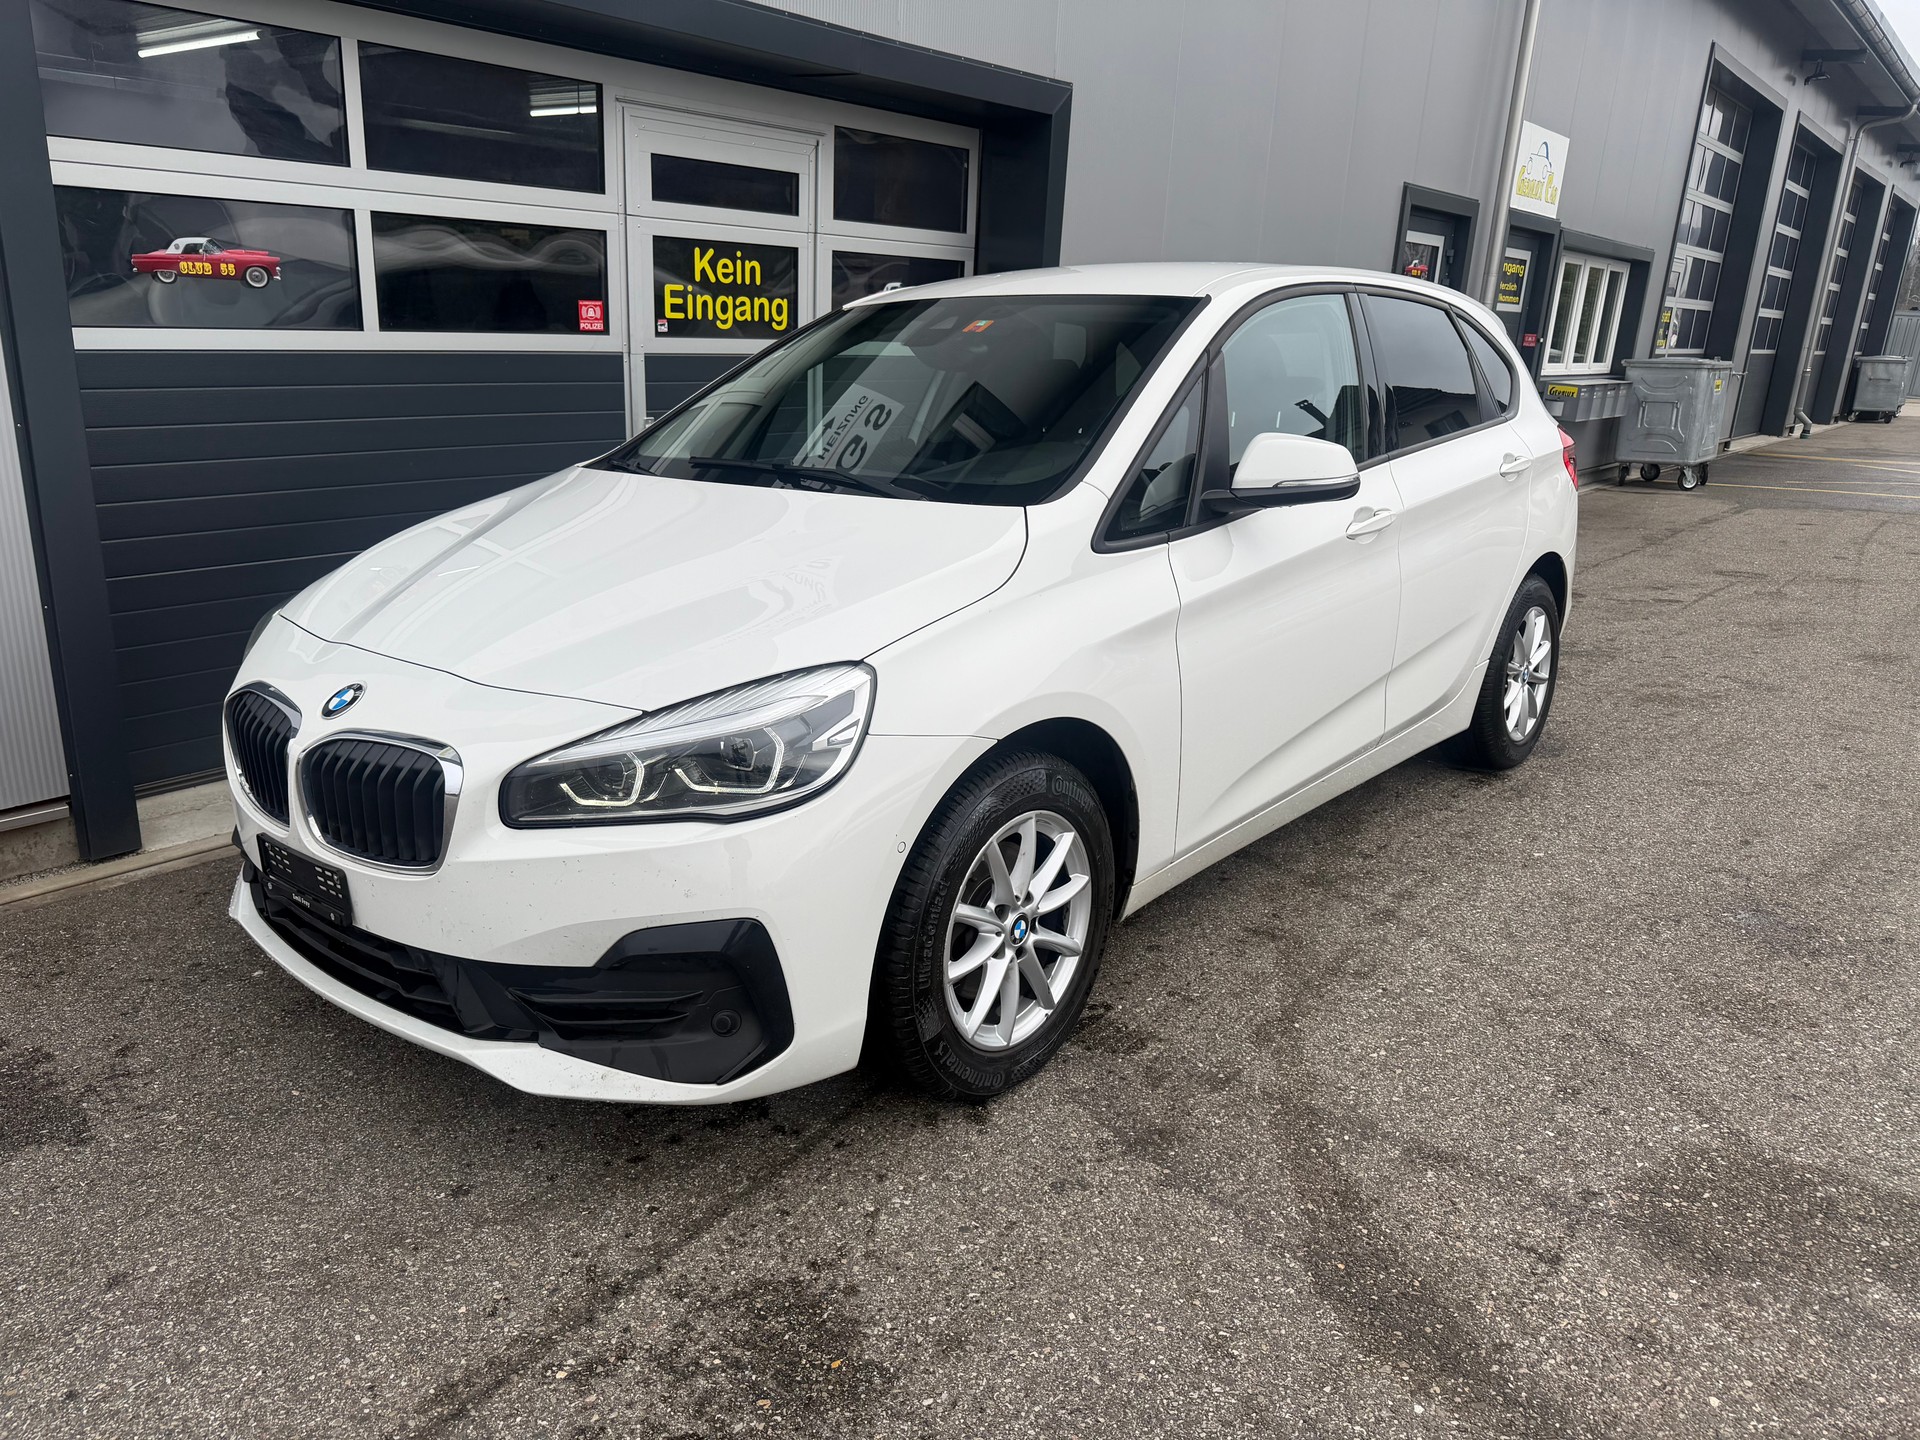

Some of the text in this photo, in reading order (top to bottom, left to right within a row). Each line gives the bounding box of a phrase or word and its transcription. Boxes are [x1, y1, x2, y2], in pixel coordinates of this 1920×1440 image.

[179, 261, 236, 276] CLUB 55
[694, 247, 761, 286] Kein
[1502, 262, 1524, 277] ngang
[664, 284, 788, 331] Eingang
[580, 323, 604, 331] POLIZEI
[940, 1048, 1006, 1091] Continental
